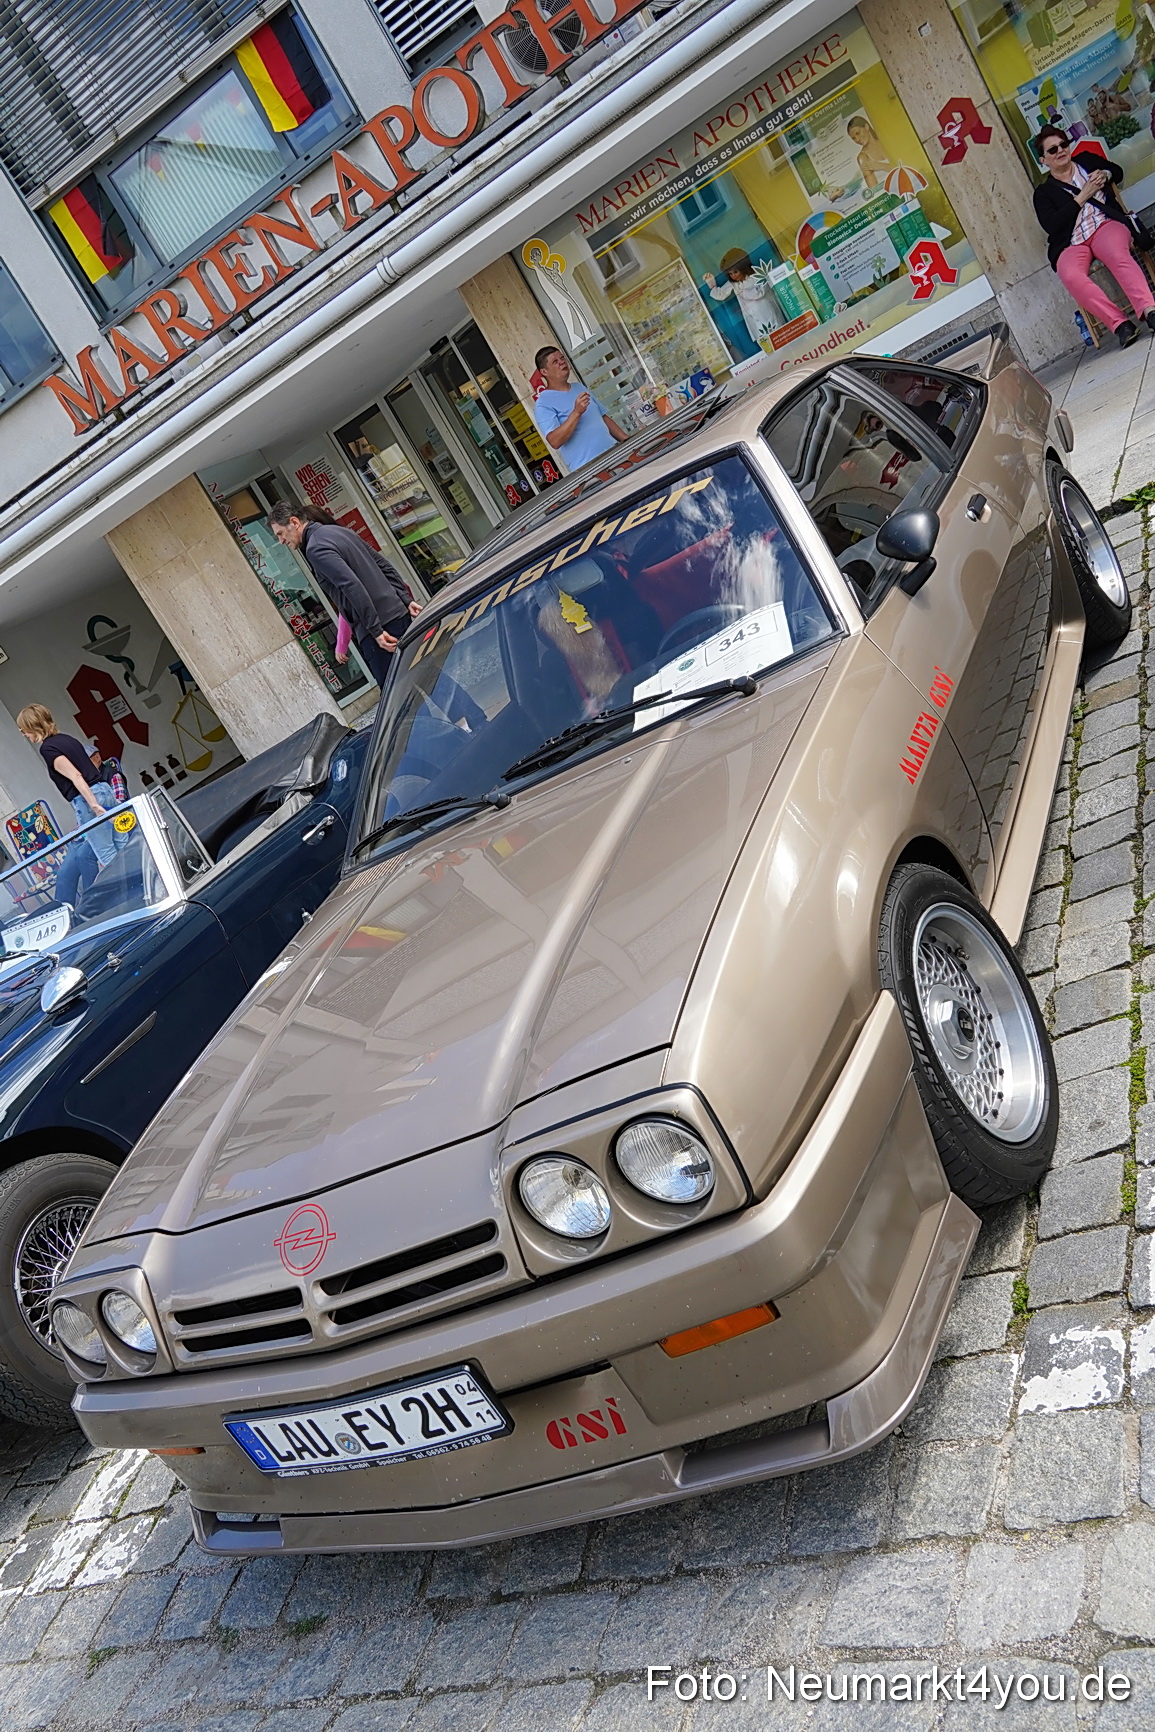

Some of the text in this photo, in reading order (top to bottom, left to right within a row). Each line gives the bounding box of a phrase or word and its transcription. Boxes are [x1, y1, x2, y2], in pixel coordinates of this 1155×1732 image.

[1035, 50, 1055, 66] Urlaub
[1055, 41, 1071, 52] ohne
[575, 33, 848, 233] MARIEN APOTHEKE
[648, 174, 694, 208] möchten,
[694, 159, 719, 178] dass
[719, 147, 733, 161] es
[733, 125, 765, 151] Ihnen
[766, 111, 784, 133] gut
[785, 89, 814, 119] geht!
[43, 0, 652, 436] MARIEN-APOTH
[825, 223, 848, 240] Trockene
[848, 215, 861, 228] Haut
[854, 215, 872, 230] Derma
[872, 207, 884, 219] Line
[779, 285, 795, 311] INGWER
[294, 463, 317, 485] WIR
[302, 471, 332, 498] SEHEN
[409, 476, 715, 671] irmscher
[719, 621, 761, 652] 343
[898, 710, 939, 785] MANTA
[454, 1380, 477, 1396] 04
[252, 1387, 473, 1463] LAU EY 2H
[475, 1408, 497, 1424] 11
[254, 1449, 267, 1461] D
[348, 1461, 371, 1471] GmbH
